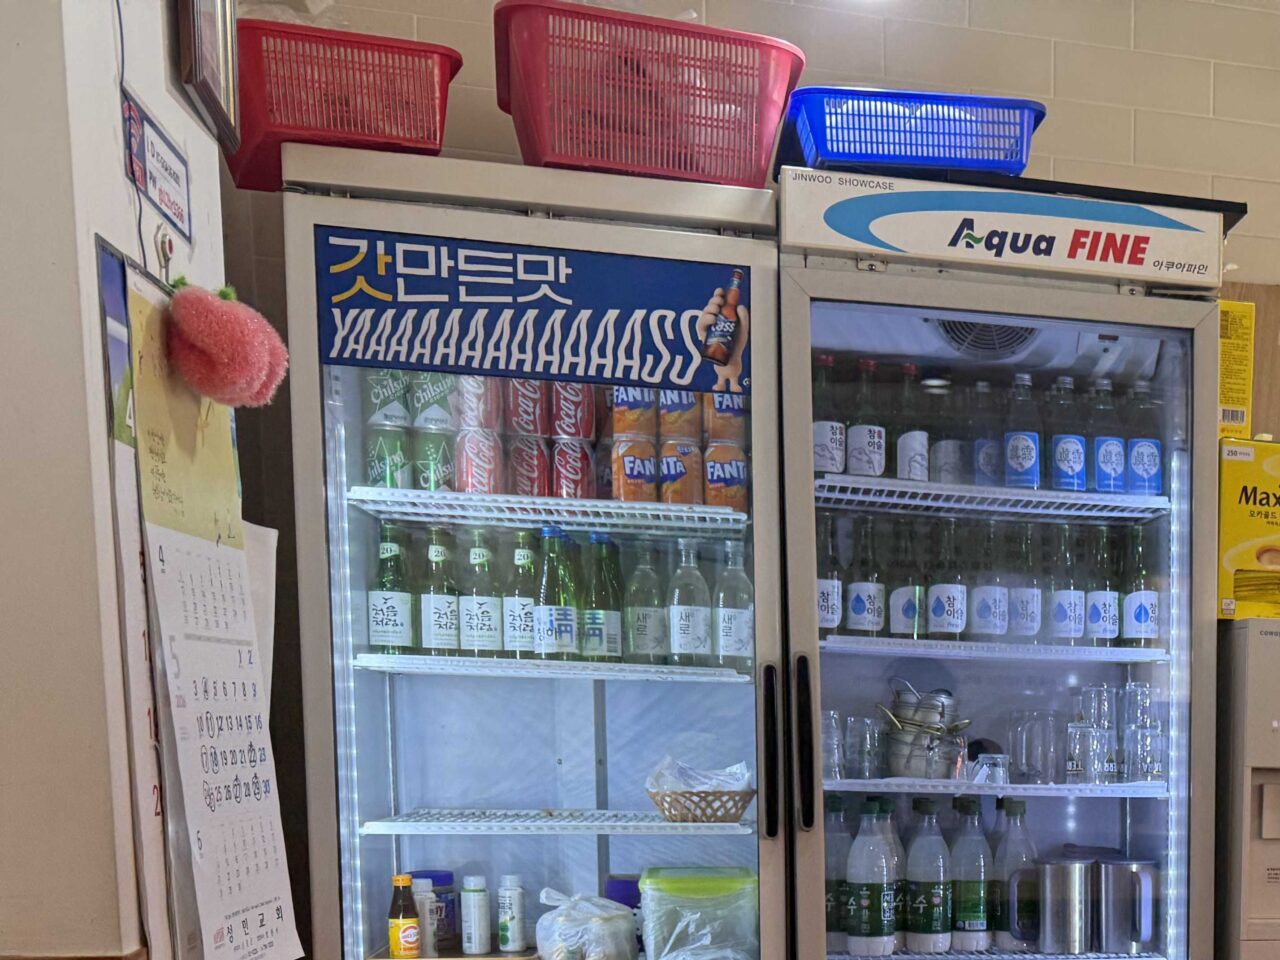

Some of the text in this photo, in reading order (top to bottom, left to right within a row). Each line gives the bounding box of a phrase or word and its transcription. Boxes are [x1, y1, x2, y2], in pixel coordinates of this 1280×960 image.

[792, 173, 895, 191] JINWOO SHOWCASE
[948, 218, 1151, 266] Aqua FINE
[329, 236, 573, 305] 갓만든맛
[1152, 259, 1209, 276] 아쿠아파인
[660, 389, 695, 404] ANTA
[714, 393, 744, 409] FAN
[624, 456, 655, 475] FAN
[706, 461, 745, 479] FANT
